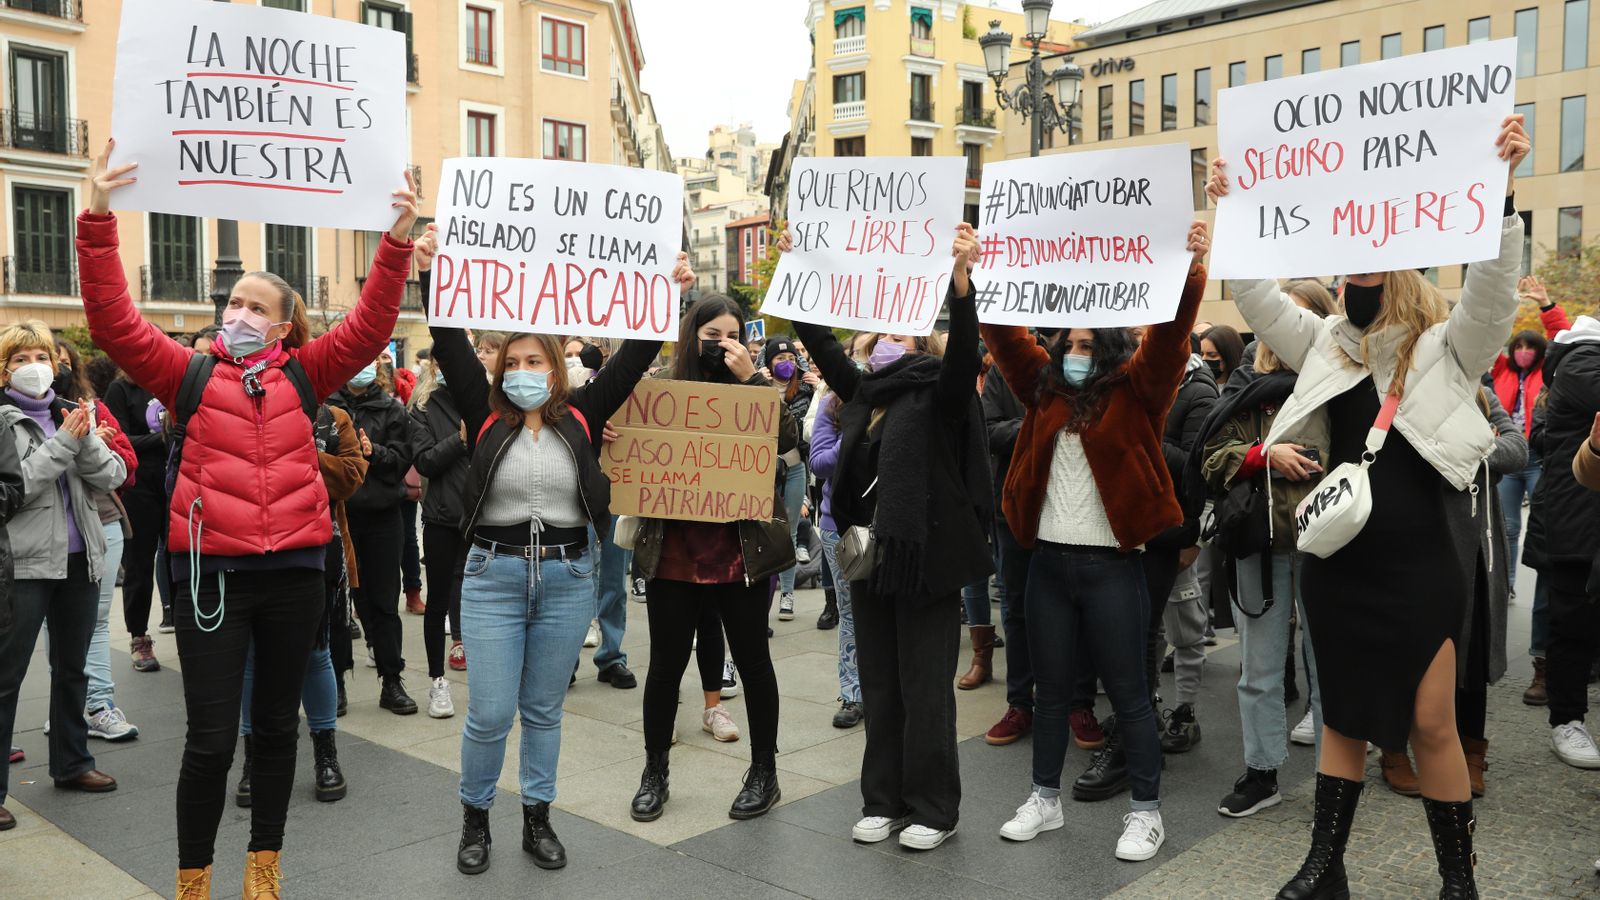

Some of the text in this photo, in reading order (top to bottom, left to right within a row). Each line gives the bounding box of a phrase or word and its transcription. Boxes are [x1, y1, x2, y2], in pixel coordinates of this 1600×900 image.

[187, 25, 358, 84] LA NOCHE
[1090, 57, 1135, 77] drive
[155, 80, 372, 129] TAMBIÉN ES
[1273, 64, 1512, 133] OCIO NOCTURNO
[180, 139, 352, 185] NUESTRA
[1238, 129, 1438, 190] SEGURO PARA
[452, 168, 663, 224] NO ES UN CASO
[798, 168, 928, 214] QUEREMOS
[793, 221, 830, 253] SER
[1259, 182, 1485, 248] LAS MUJERES
[556, 233, 578, 257] SE
[588, 233, 658, 266] LLAMA
[777, 270, 822, 312] NO
[624, 390, 775, 434] NO ES UN
[606, 433, 673, 466] CASO
[609, 466, 701, 486] SE LLAMA
